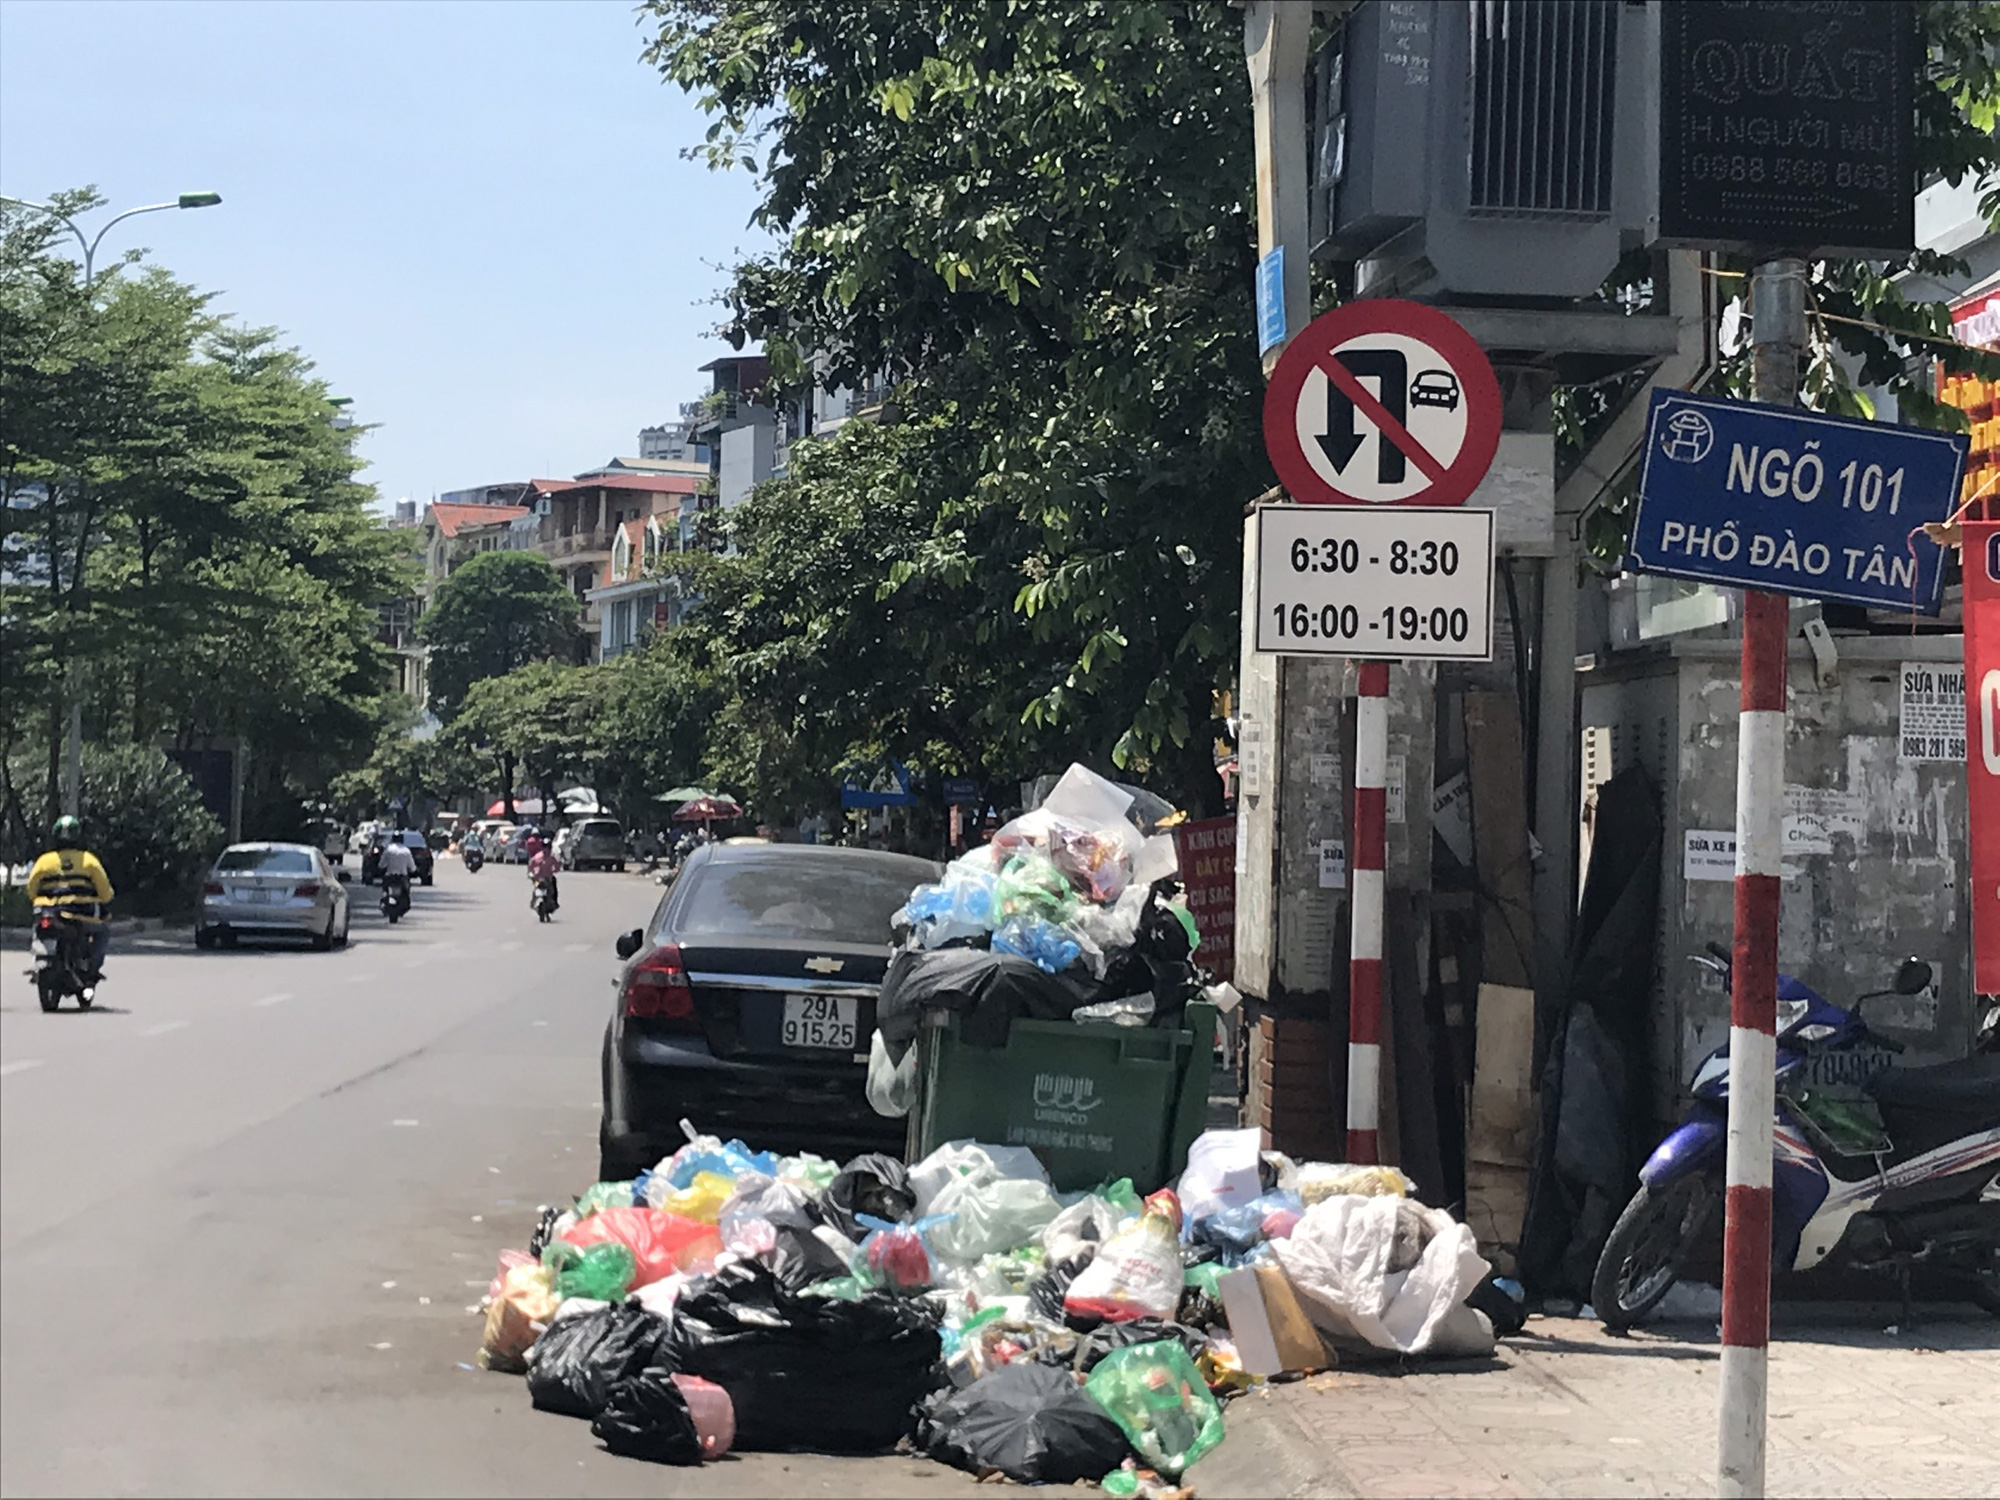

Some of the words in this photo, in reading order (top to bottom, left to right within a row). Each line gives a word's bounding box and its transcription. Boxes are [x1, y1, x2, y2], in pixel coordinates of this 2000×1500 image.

[1725, 440, 1824, 503] NGÕ
[1839, 460, 1905, 516] 101
[1291, 538, 1359, 573] 6:30
[1389, 540, 1459, 576] 8:30
[1661, 520, 1740, 562] PHỐ
[1749, 529, 1831, 575] ĐÀO
[1843, 545, 1915, 589] TÂN
[1273, 603, 1359, 639] 16:00
[1904, 664, 1933, 693] SỬA
[801, 997, 839, 1021] 29A
[785, 1020, 854, 1047] 915.25
